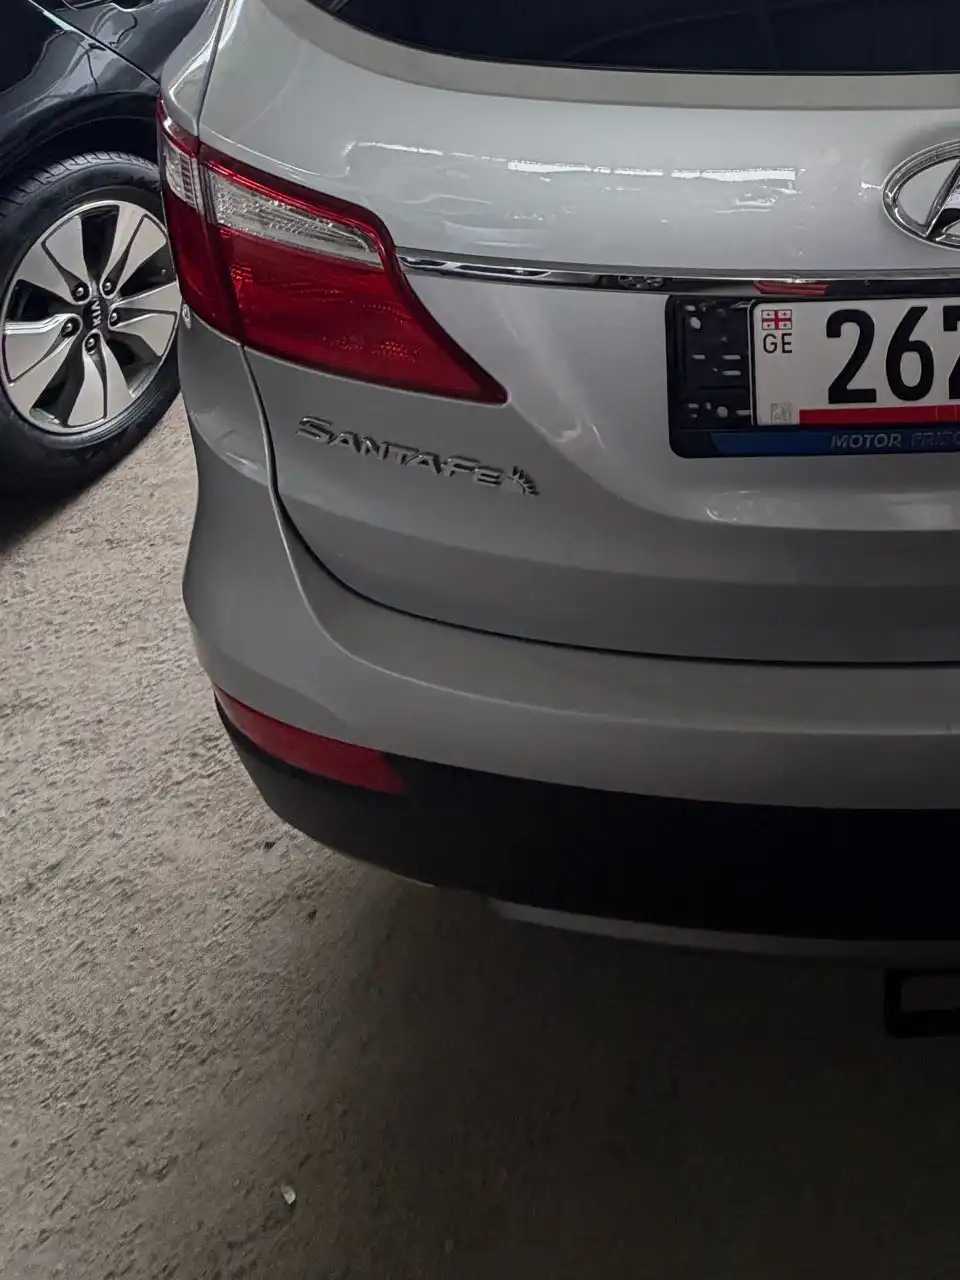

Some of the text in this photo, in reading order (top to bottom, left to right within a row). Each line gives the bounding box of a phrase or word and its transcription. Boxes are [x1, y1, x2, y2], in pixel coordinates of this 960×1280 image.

[91, 299, 102, 327] KIA
[763, 332, 793, 354] GE
[830, 433, 902, 449] MOTOR
